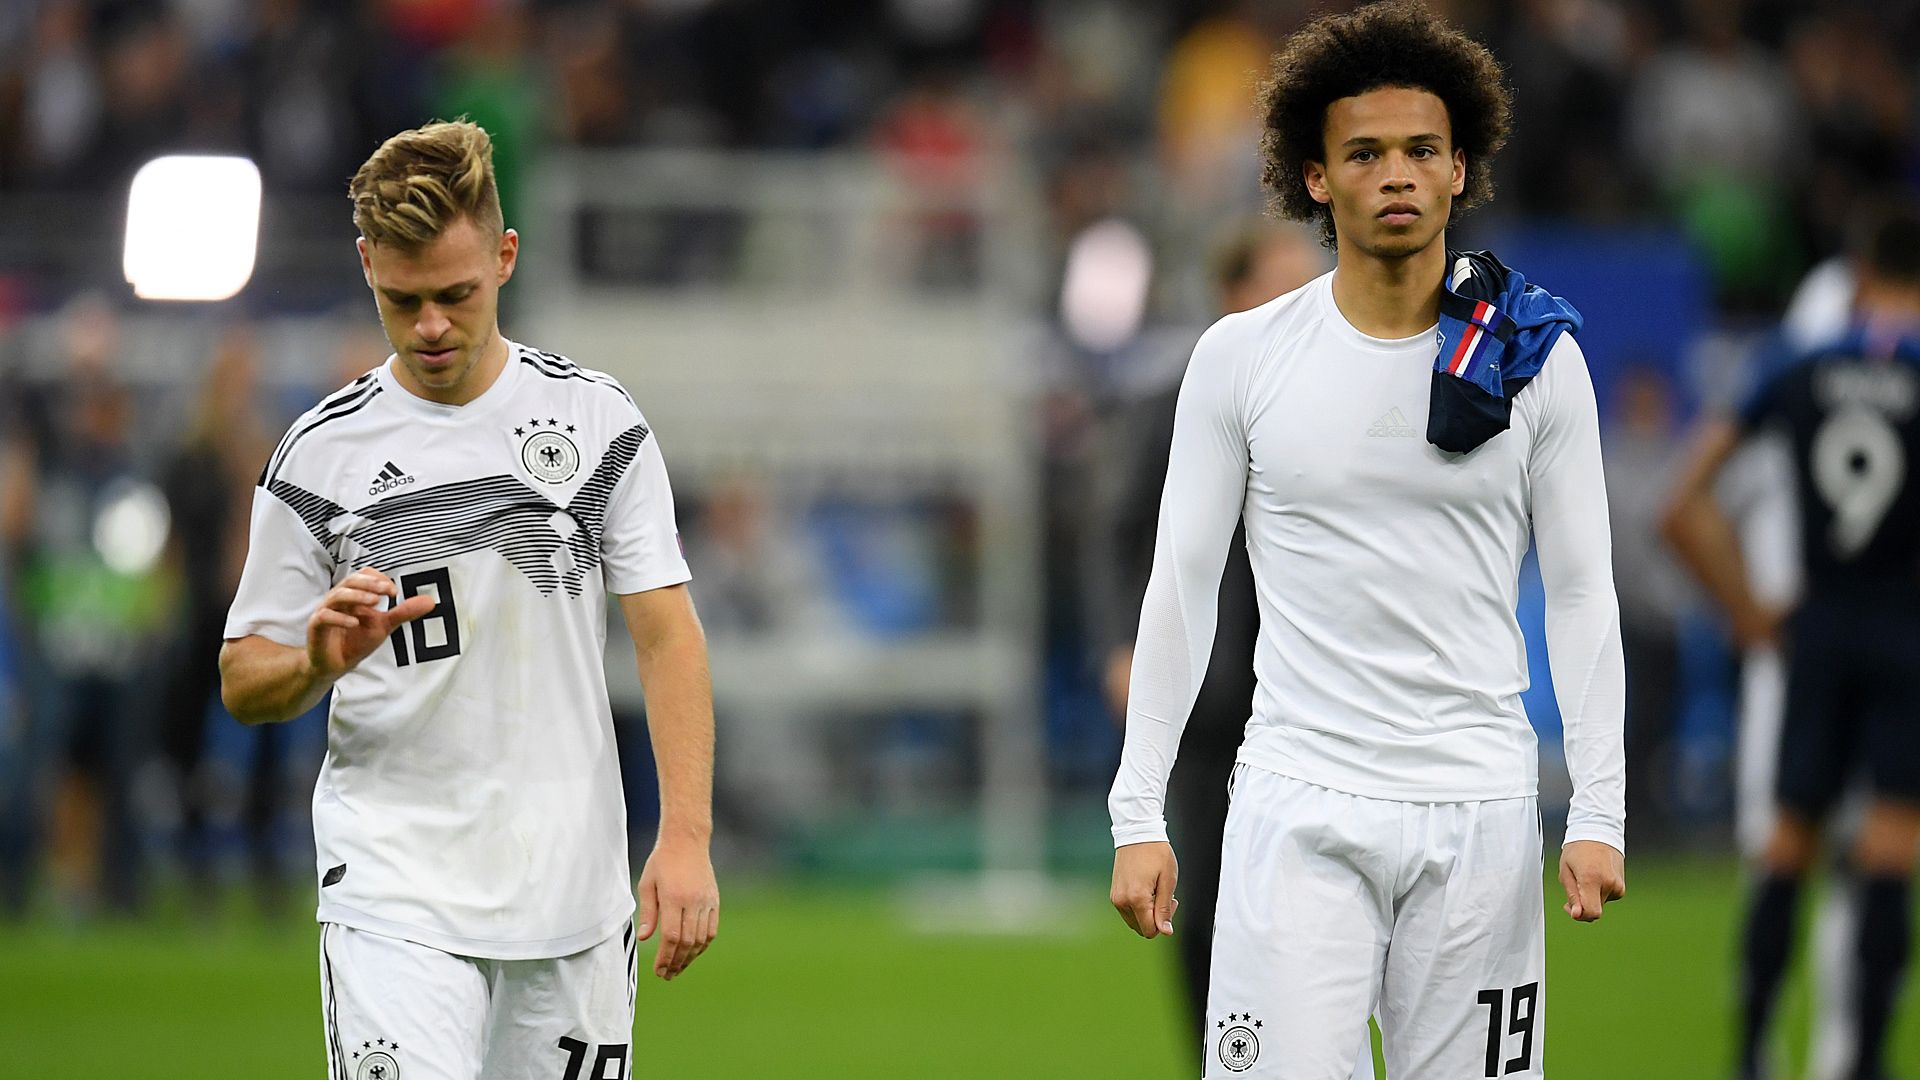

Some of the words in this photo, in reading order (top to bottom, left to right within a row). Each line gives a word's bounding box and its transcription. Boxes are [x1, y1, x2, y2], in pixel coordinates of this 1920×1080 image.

[369, 475, 415, 495] adidas
[1811, 400, 1905, 557] 9
[1477, 981, 1539, 1077] 19
